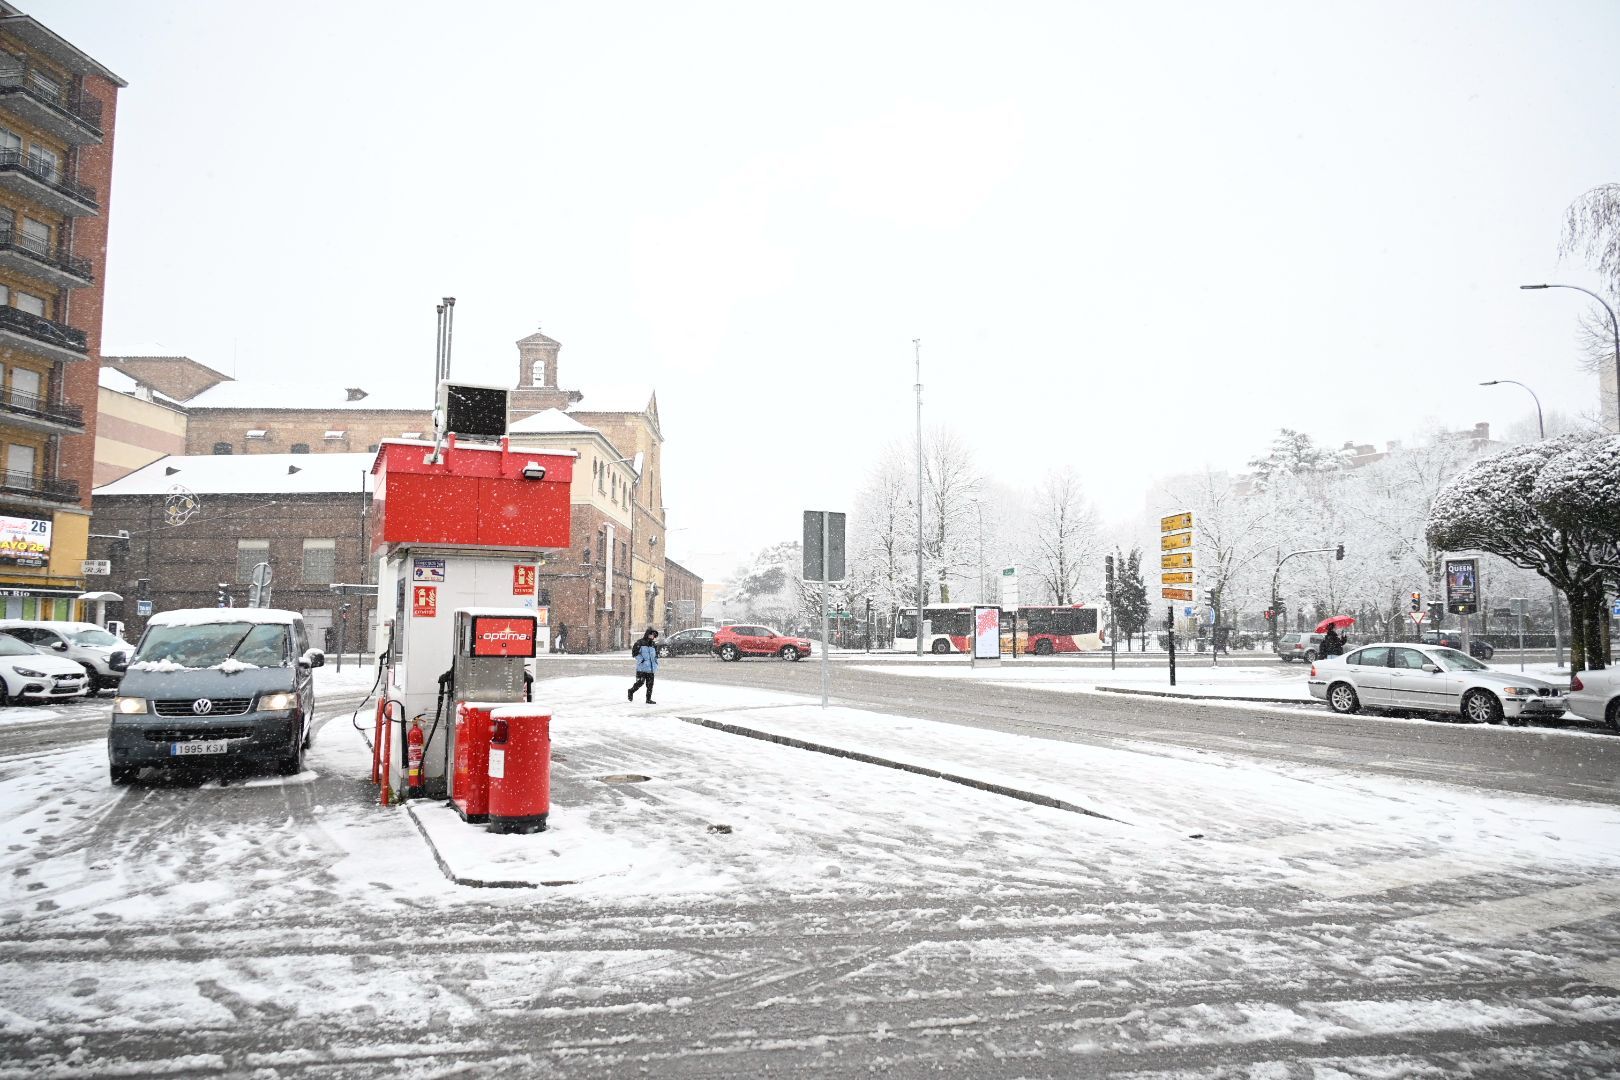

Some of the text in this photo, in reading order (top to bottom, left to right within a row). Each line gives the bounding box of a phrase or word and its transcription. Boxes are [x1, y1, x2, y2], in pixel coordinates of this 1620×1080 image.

[31, 520, 47, 532] 26
[1448, 565, 1472, 573] QUEEN
[483, 632, 527, 642] optima
[179, 744, 225, 754] 1995 KSX
